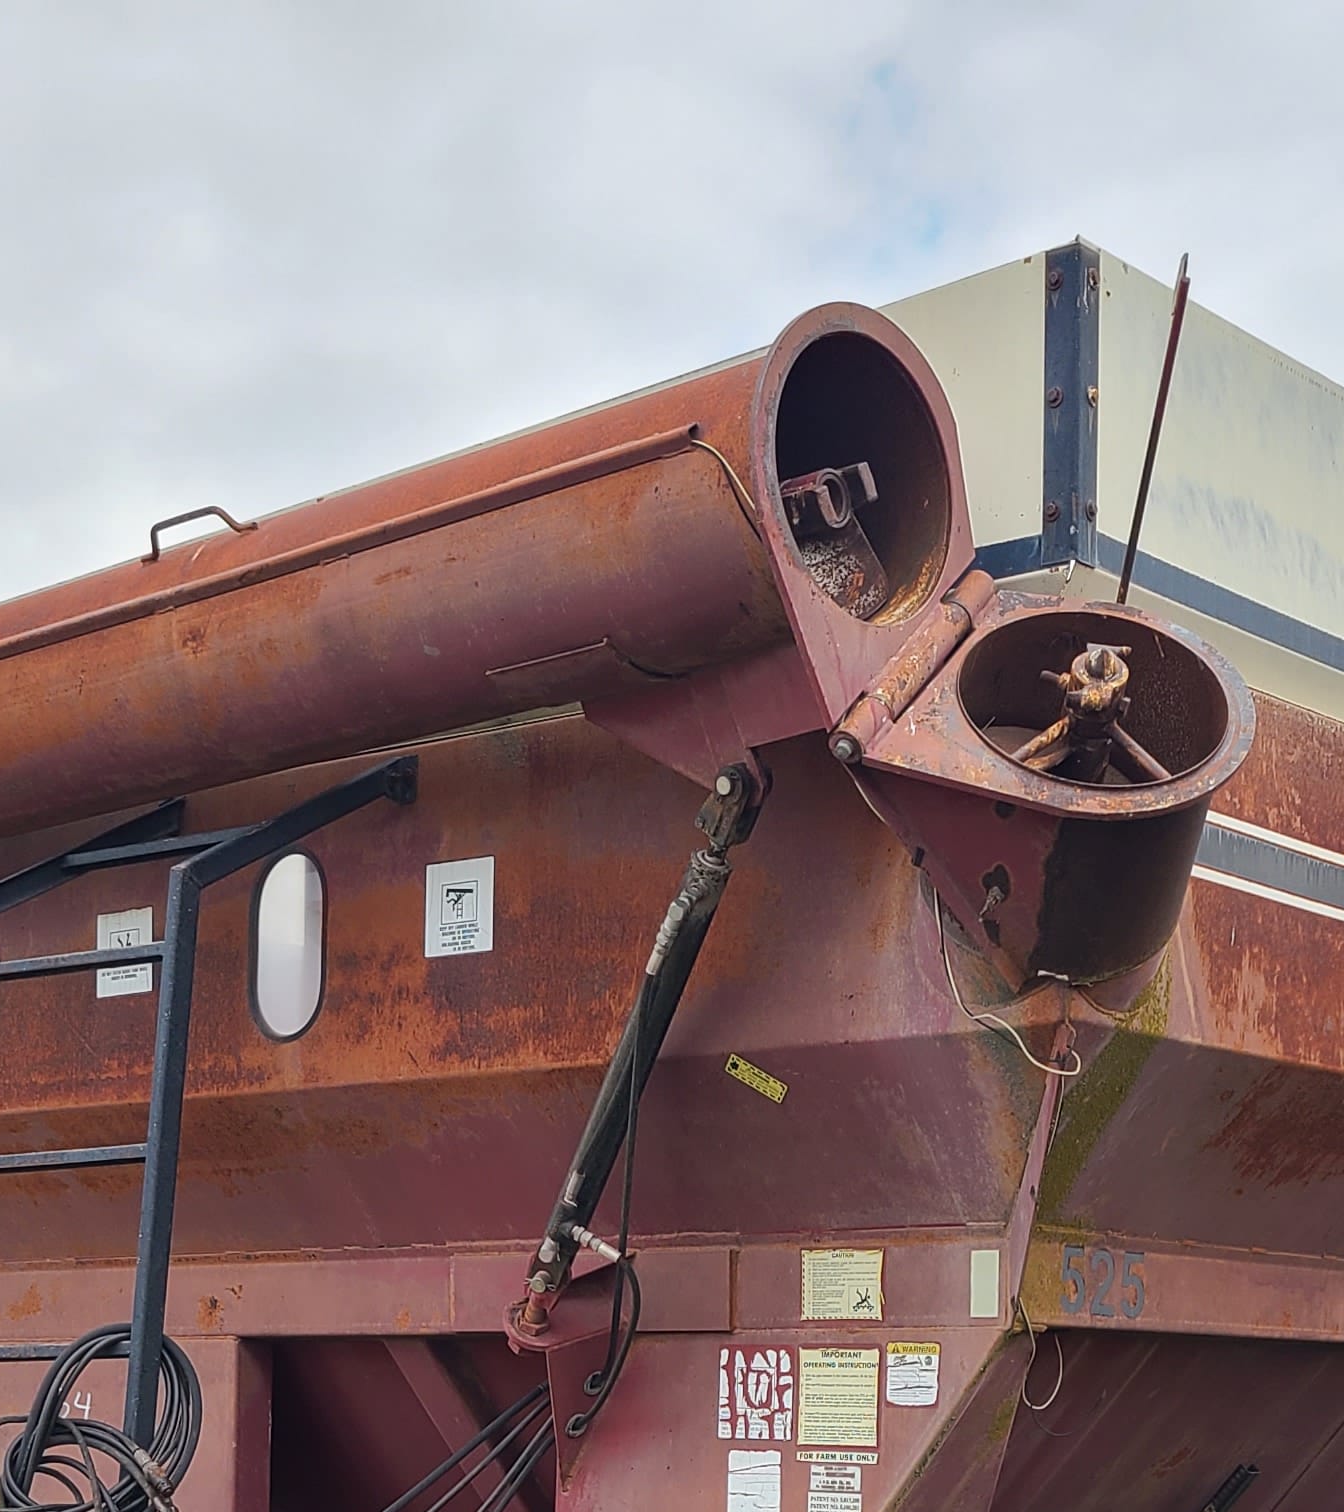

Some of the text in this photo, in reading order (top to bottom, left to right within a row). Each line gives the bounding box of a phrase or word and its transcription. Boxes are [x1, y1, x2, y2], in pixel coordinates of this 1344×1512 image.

[1060, 1245, 1145, 1318] 525
[902, 1344, 937, 1353] WARNING
[821, 1351, 862, 1359] IMPORTANT
[803, 1361, 836, 1369] OPERATING
[799, 1452, 814, 1460] FOR
[839, 1453, 853, 1461] USE
[856, 1454, 875, 1462] ONLY
